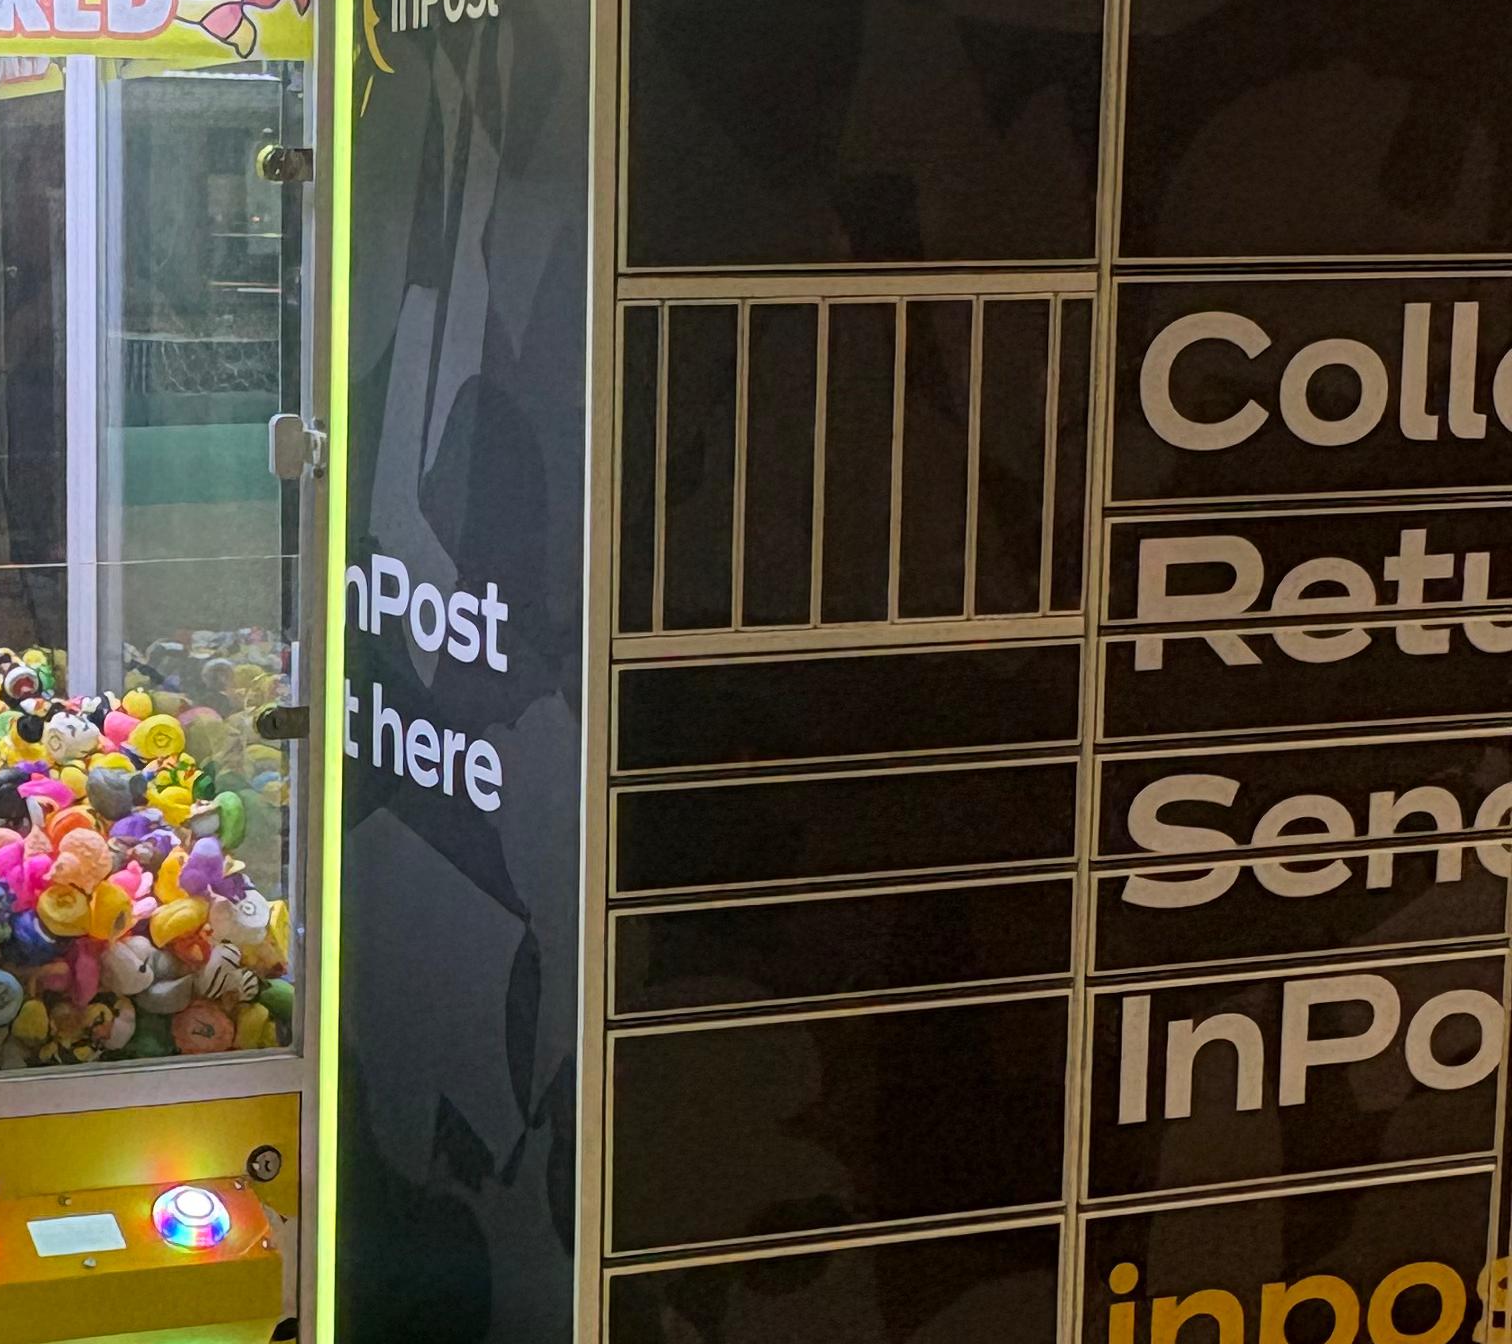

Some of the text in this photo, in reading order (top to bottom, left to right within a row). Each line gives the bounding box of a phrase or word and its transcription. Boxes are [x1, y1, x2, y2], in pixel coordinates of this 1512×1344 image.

[1140, 301, 1512, 451] Coll
[345, 554, 508, 672] nPost
[372, 682, 502, 812] here
